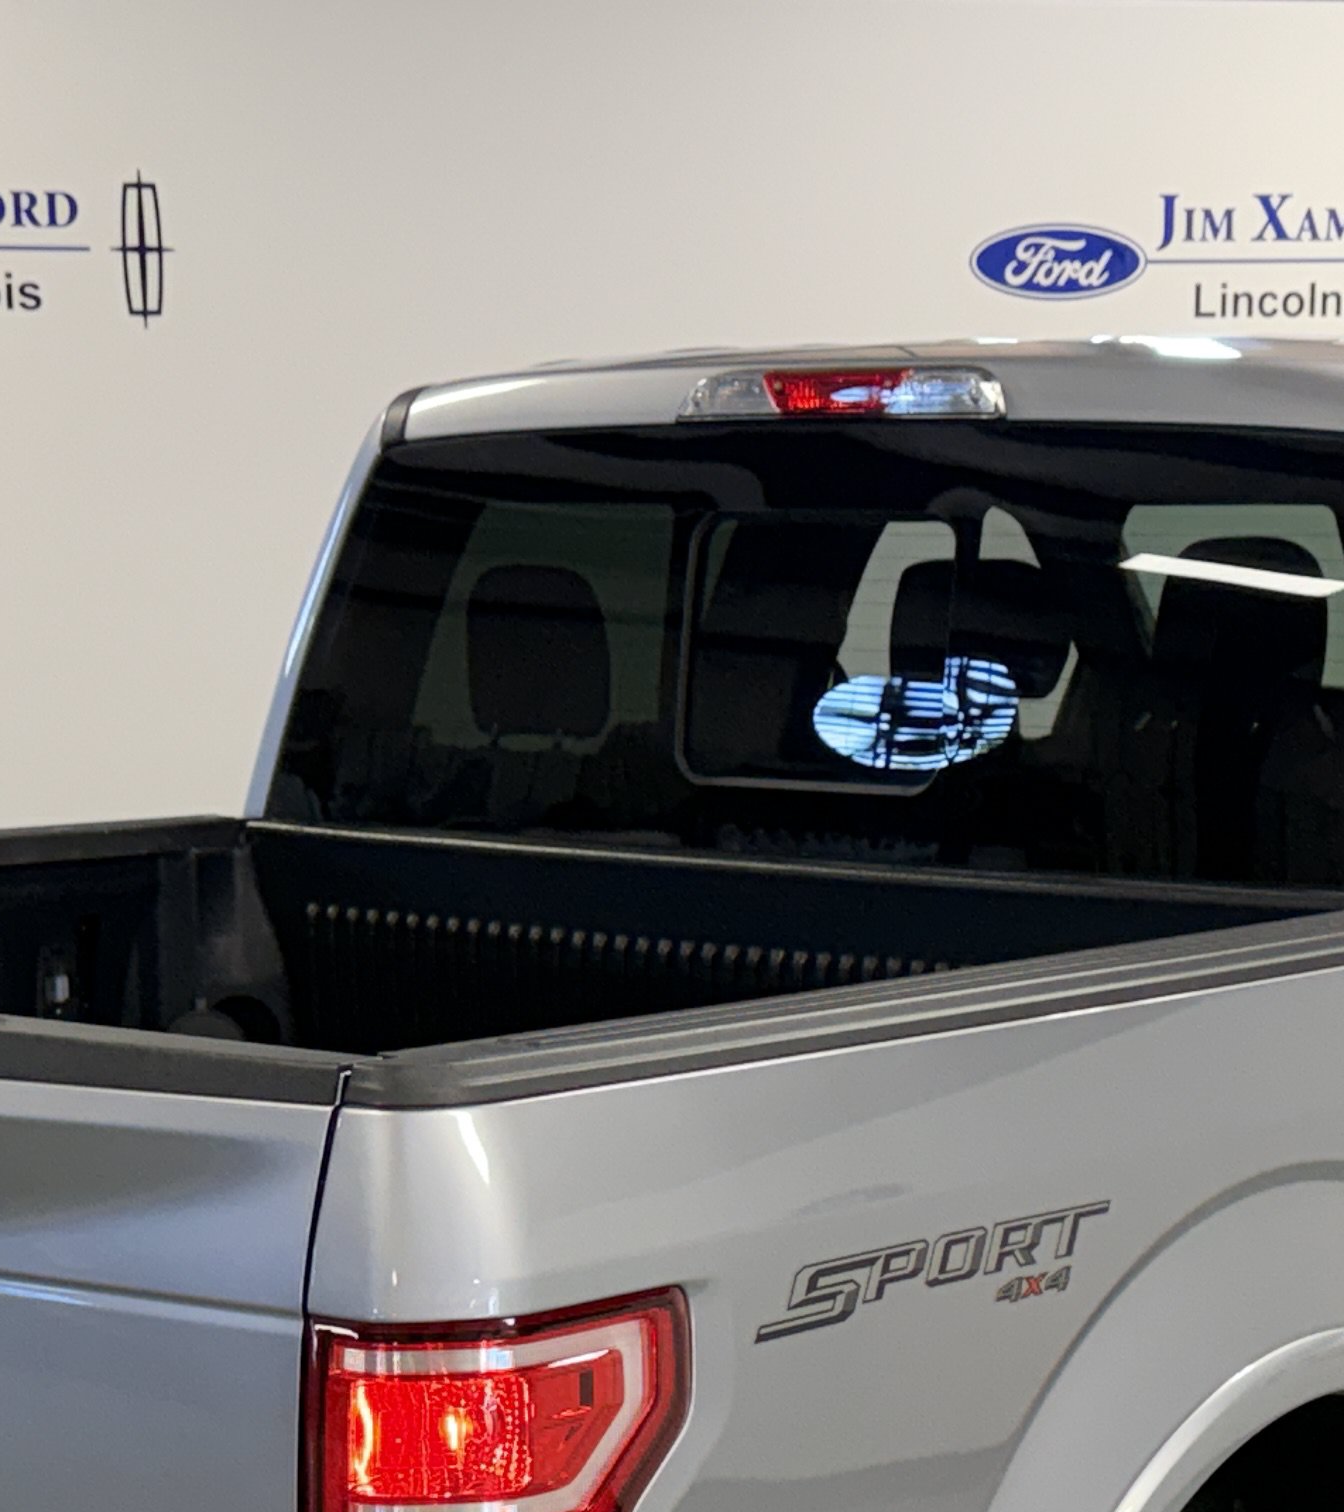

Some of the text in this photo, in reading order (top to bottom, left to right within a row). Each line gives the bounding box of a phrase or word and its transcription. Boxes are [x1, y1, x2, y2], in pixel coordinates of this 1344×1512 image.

[1156, 193, 1235, 251] JIM
[1002, 236, 1109, 288] Ford
[754, 1199, 1111, 1344] SPORT
